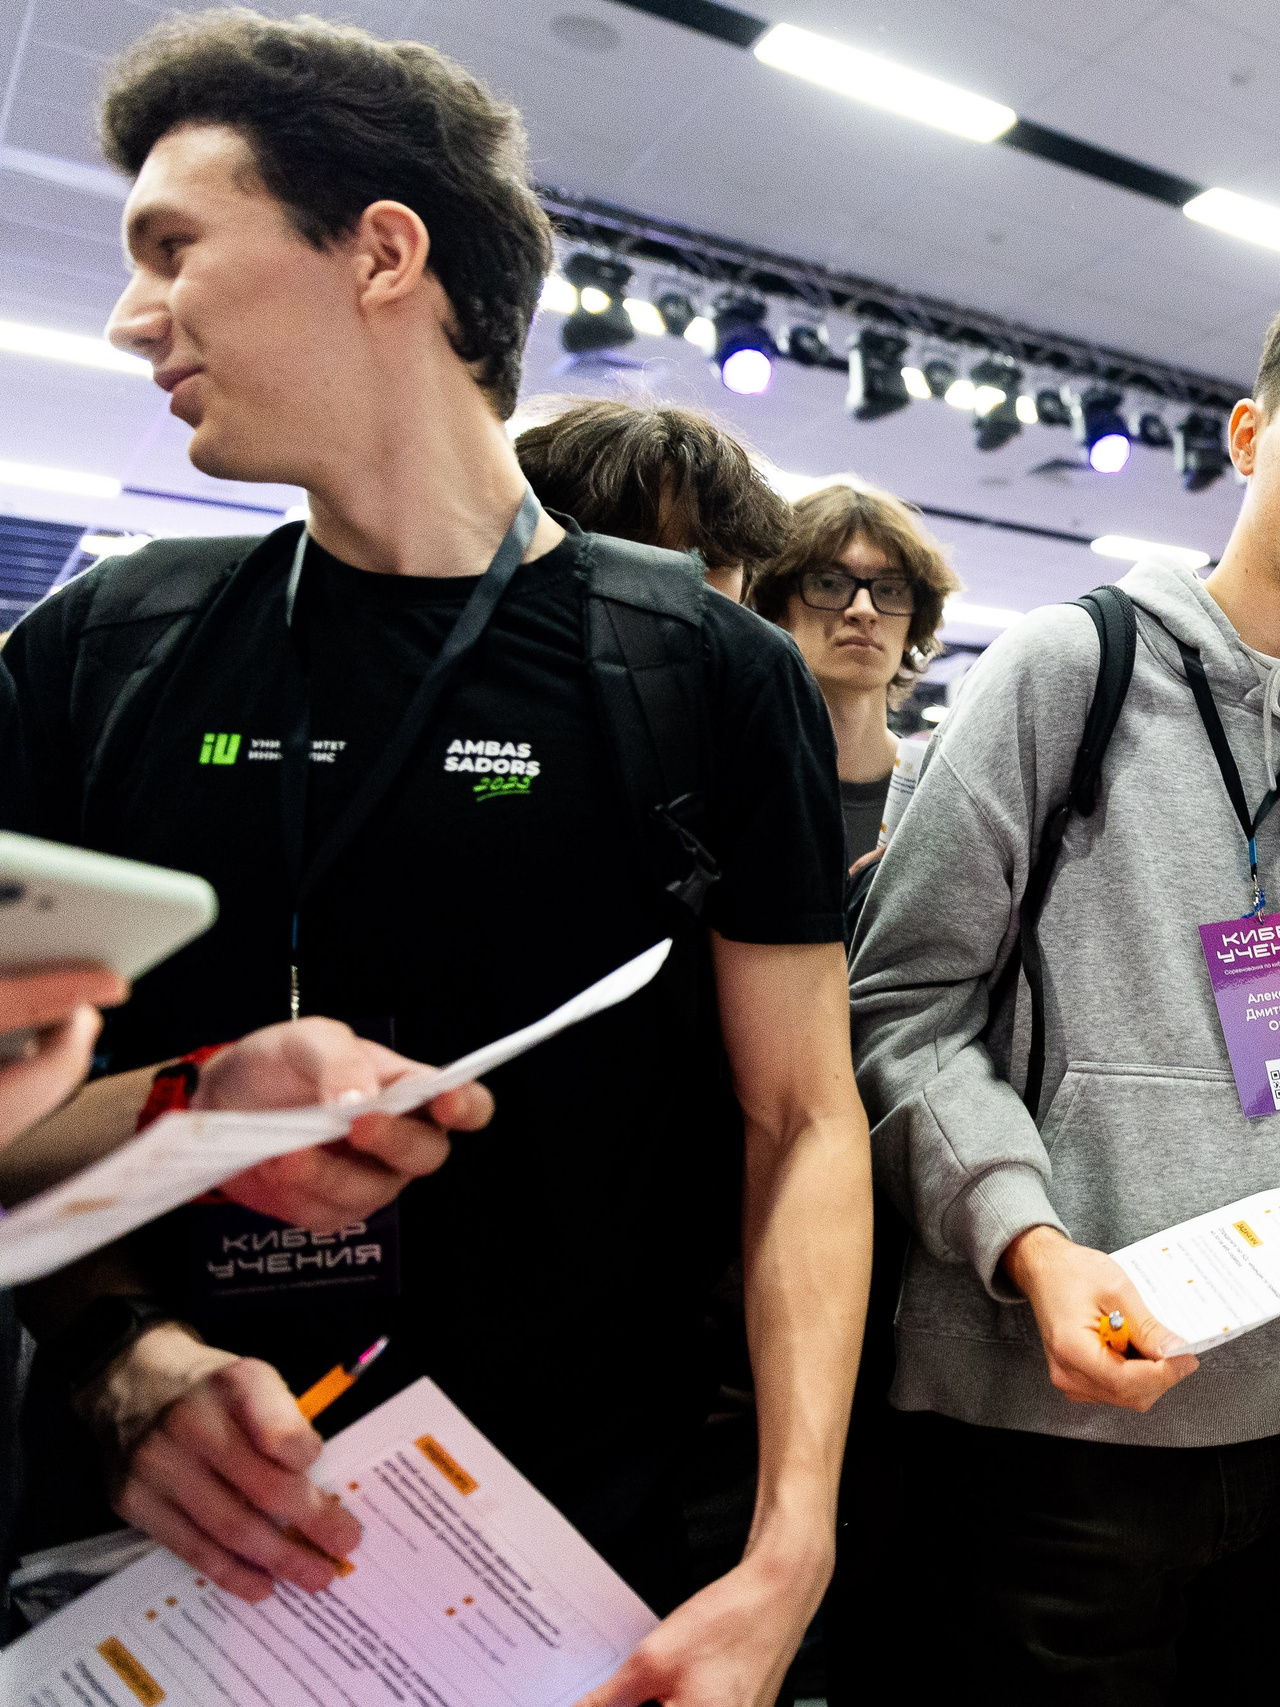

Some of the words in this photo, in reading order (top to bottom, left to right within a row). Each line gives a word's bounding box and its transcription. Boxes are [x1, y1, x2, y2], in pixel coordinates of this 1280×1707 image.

[446, 739, 532, 759] AMBAS
[443, 756, 541, 777] SADORS
[222, 1221, 368, 1254] КИБЕР
[206, 1243, 382, 1280] УЧЕНИЯ
